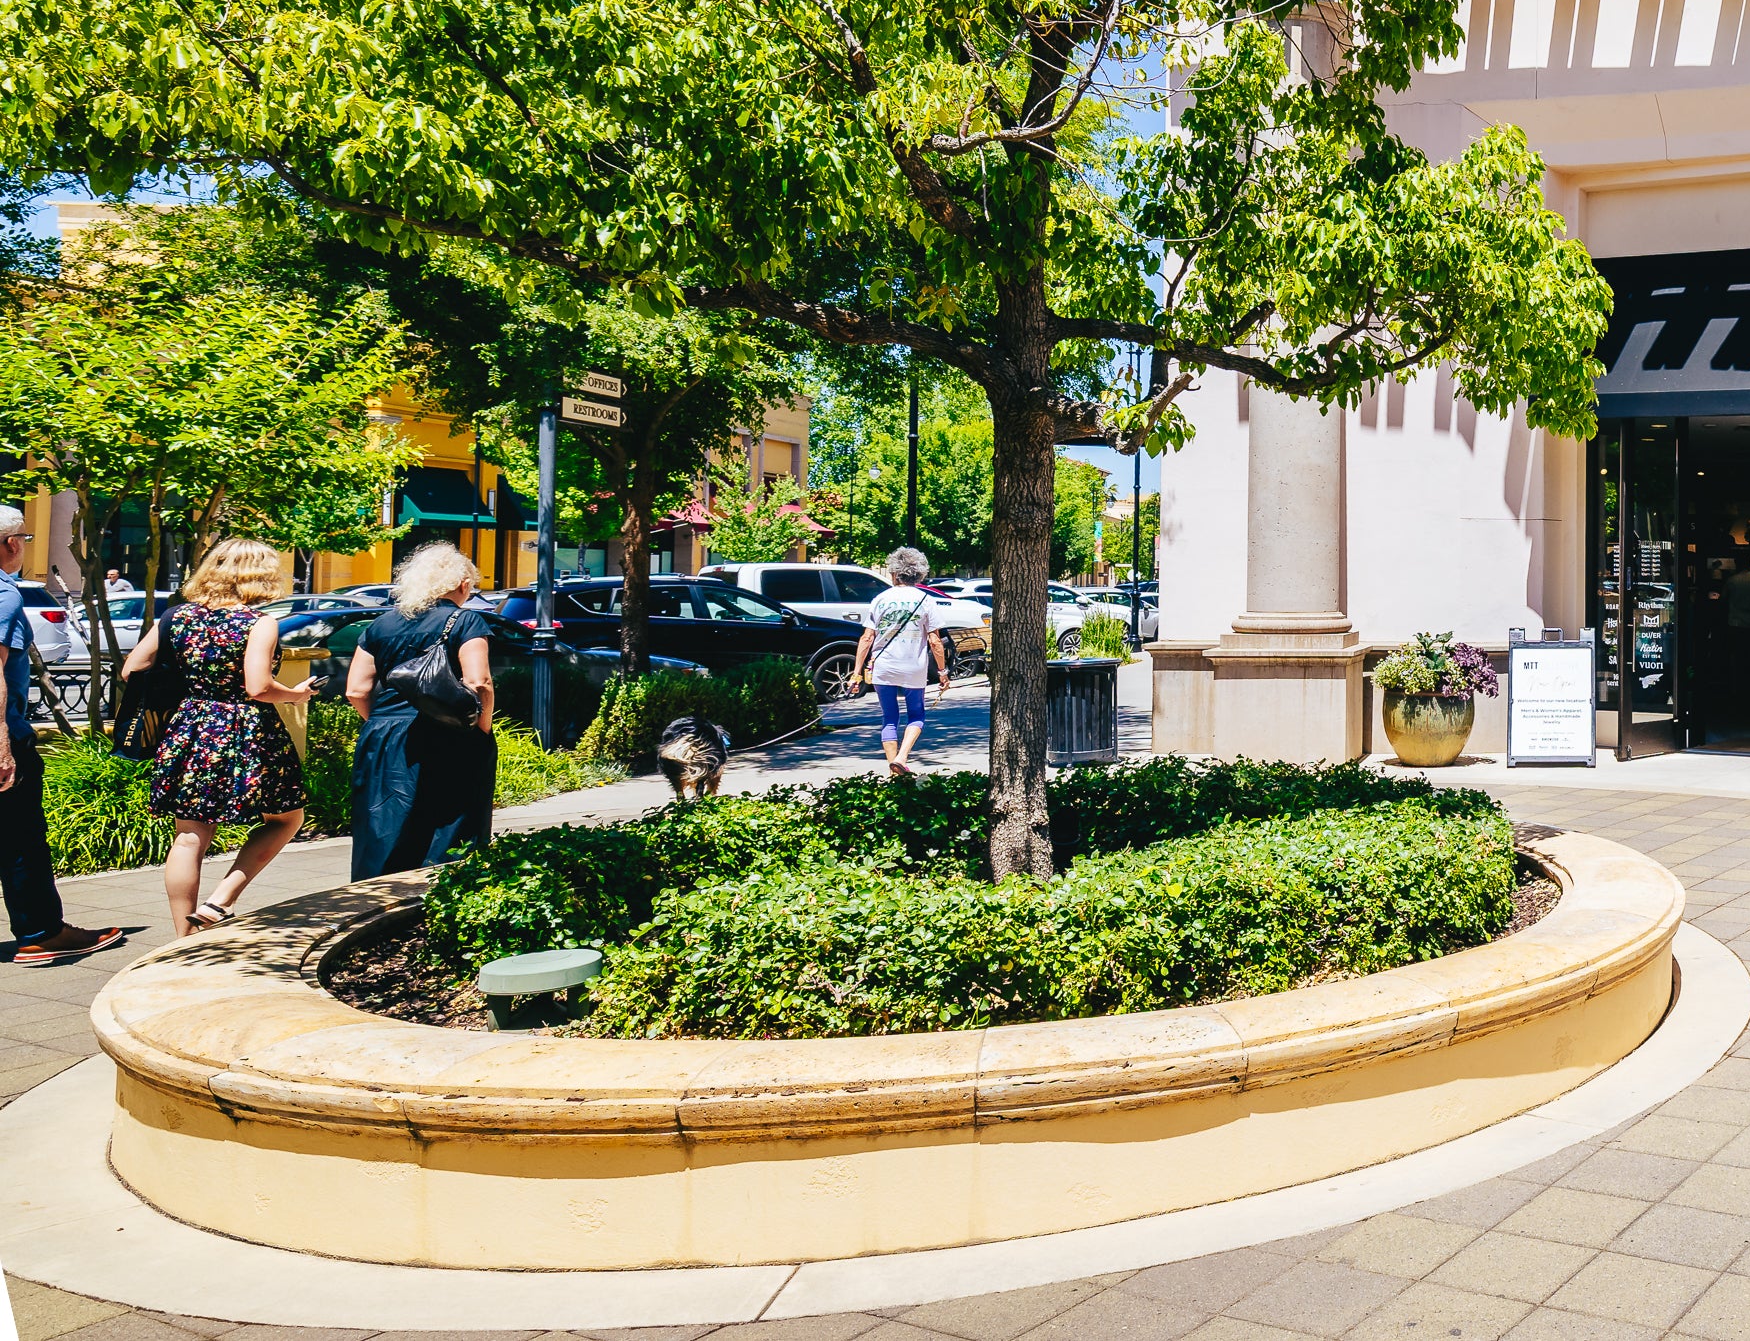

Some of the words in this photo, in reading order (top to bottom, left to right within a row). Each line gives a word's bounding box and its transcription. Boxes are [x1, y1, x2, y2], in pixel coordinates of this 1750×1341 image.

[588, 377, 619, 392] OFFICES
[573, 404, 618, 421] RESTROOMS
[1523, 661, 1539, 670] MTT
